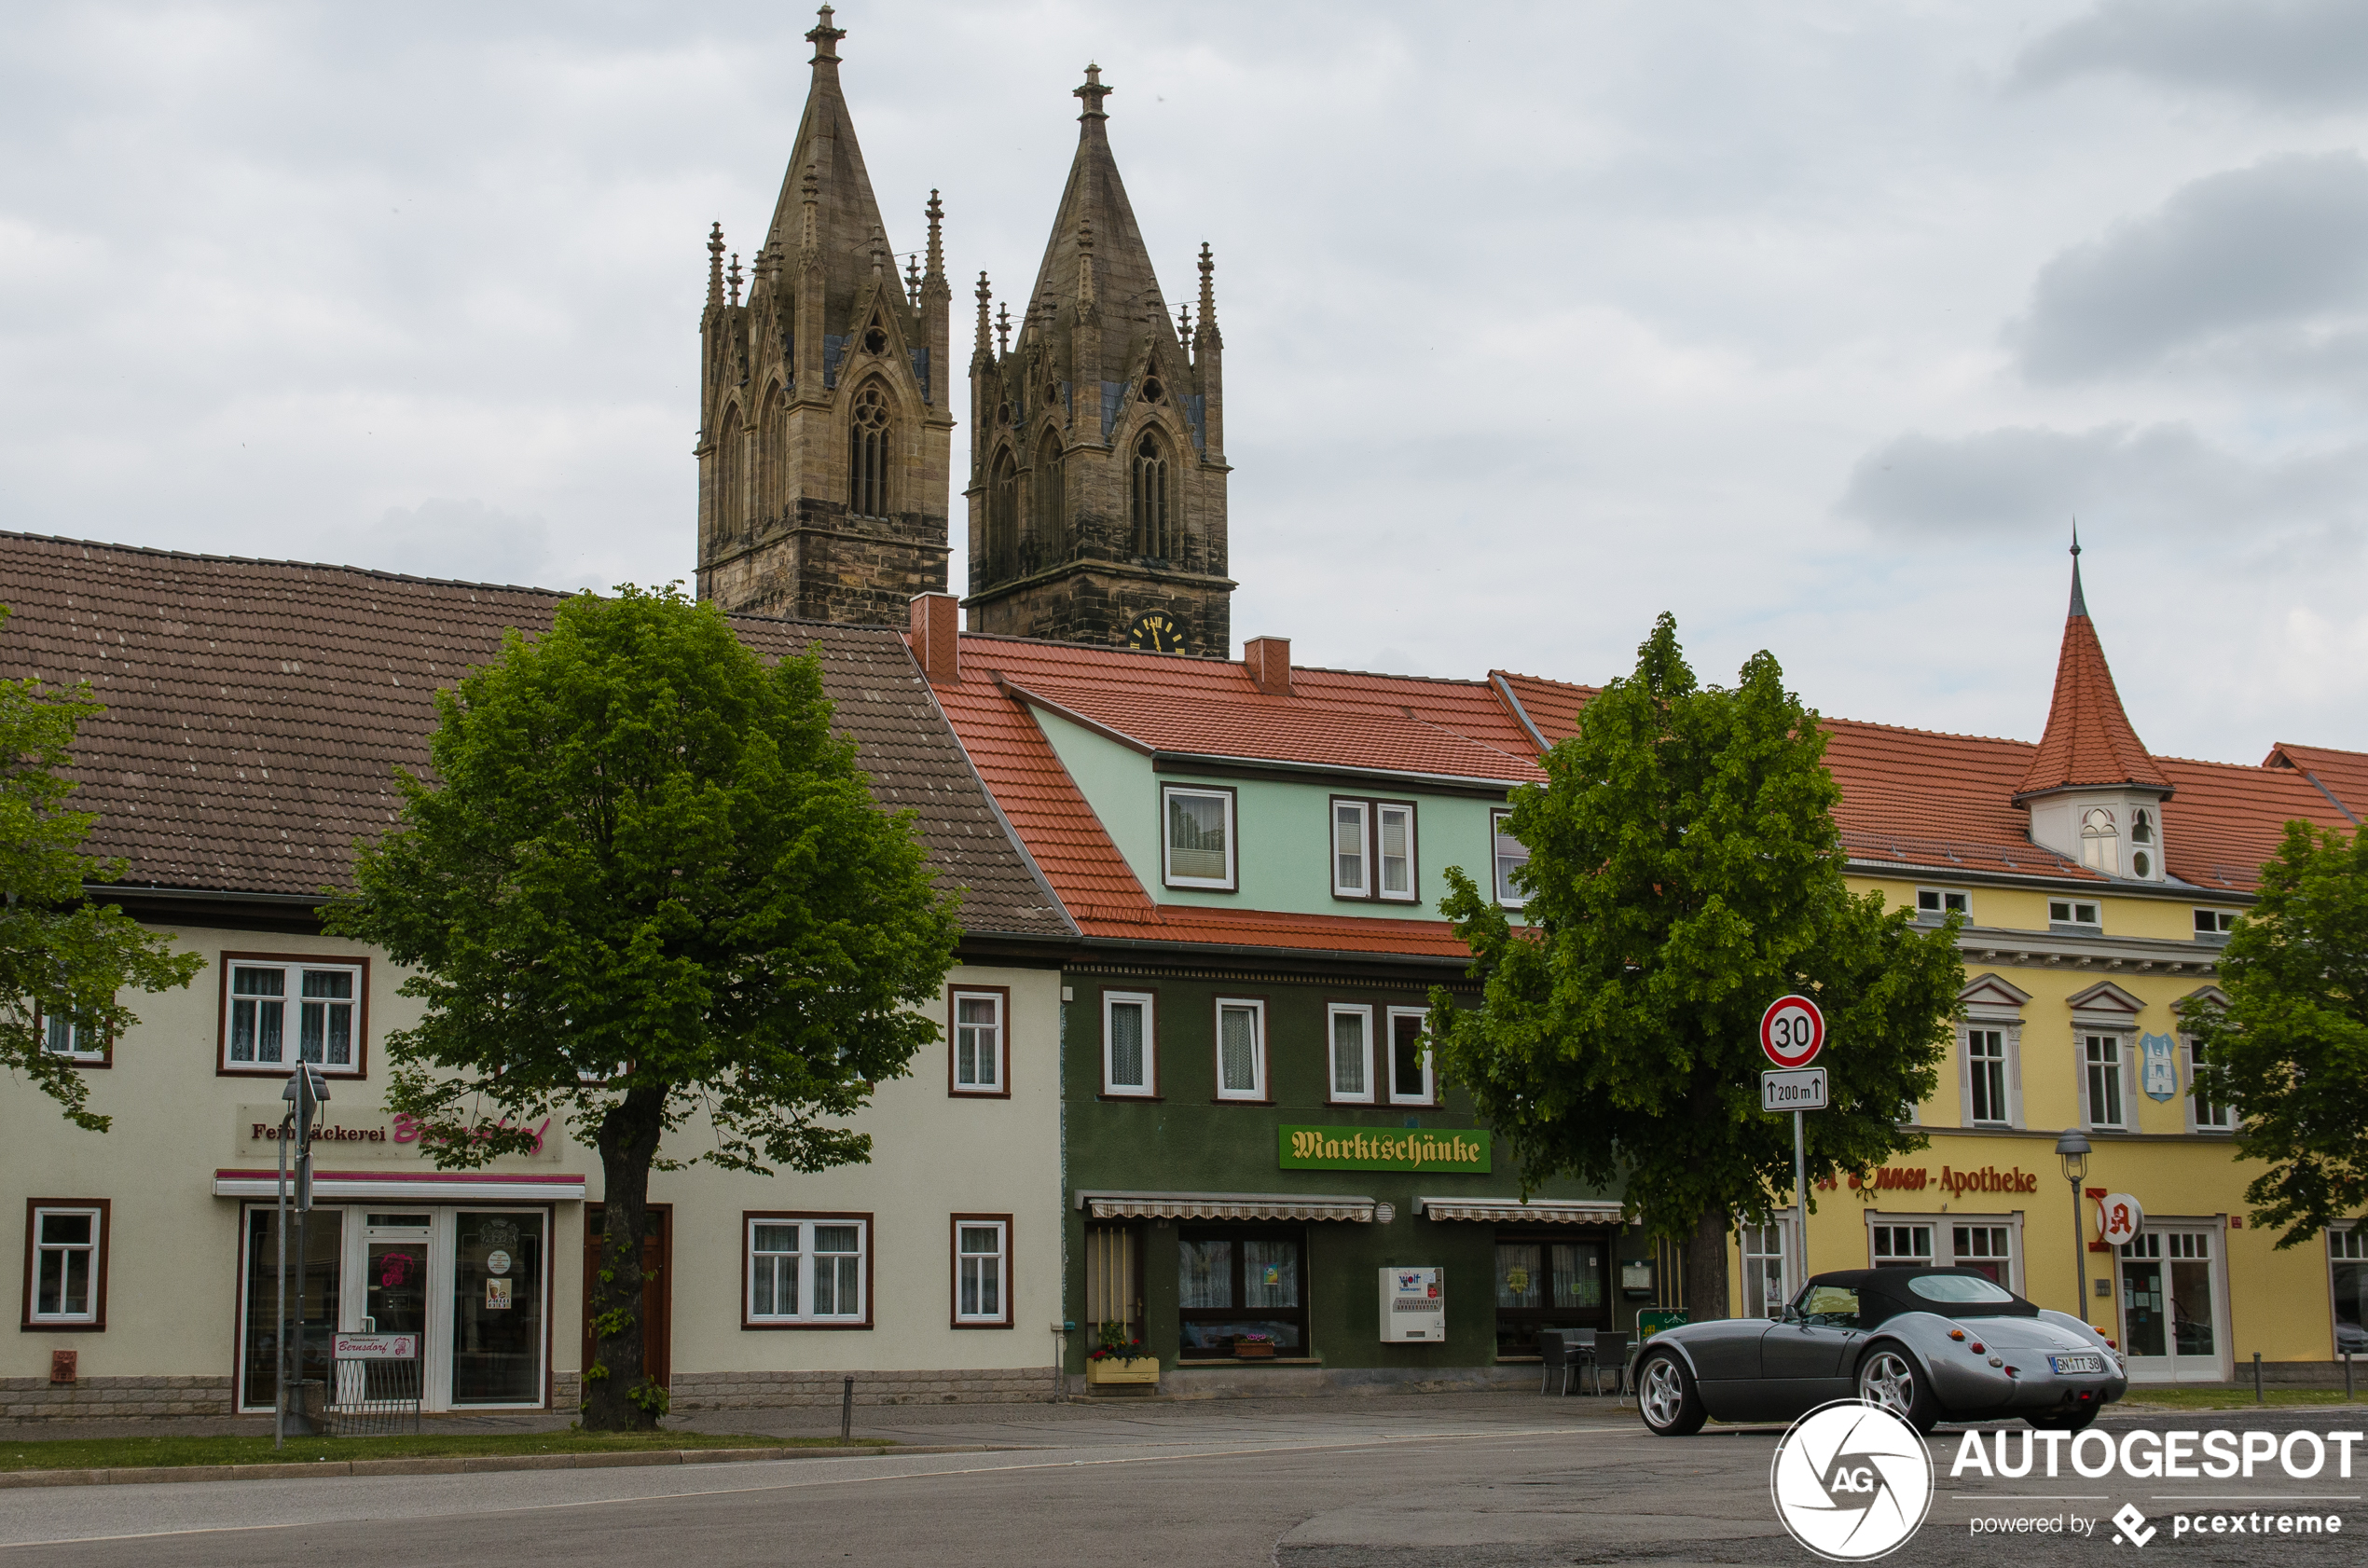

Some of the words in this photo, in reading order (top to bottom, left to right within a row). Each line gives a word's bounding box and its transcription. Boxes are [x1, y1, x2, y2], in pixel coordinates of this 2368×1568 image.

[1774, 1015, 1810, 1049] 30
[1778, 1085, 1798, 1101] 200
[1800, 1087, 1810, 1099] m
[252, 1123, 387, 1142] Feinäckerei
[1291, 1131, 1480, 1169] Marktschänke
[338, 1341, 388, 1354] Bernsdorf
[2086, 1357, 2100, 1369] 38
